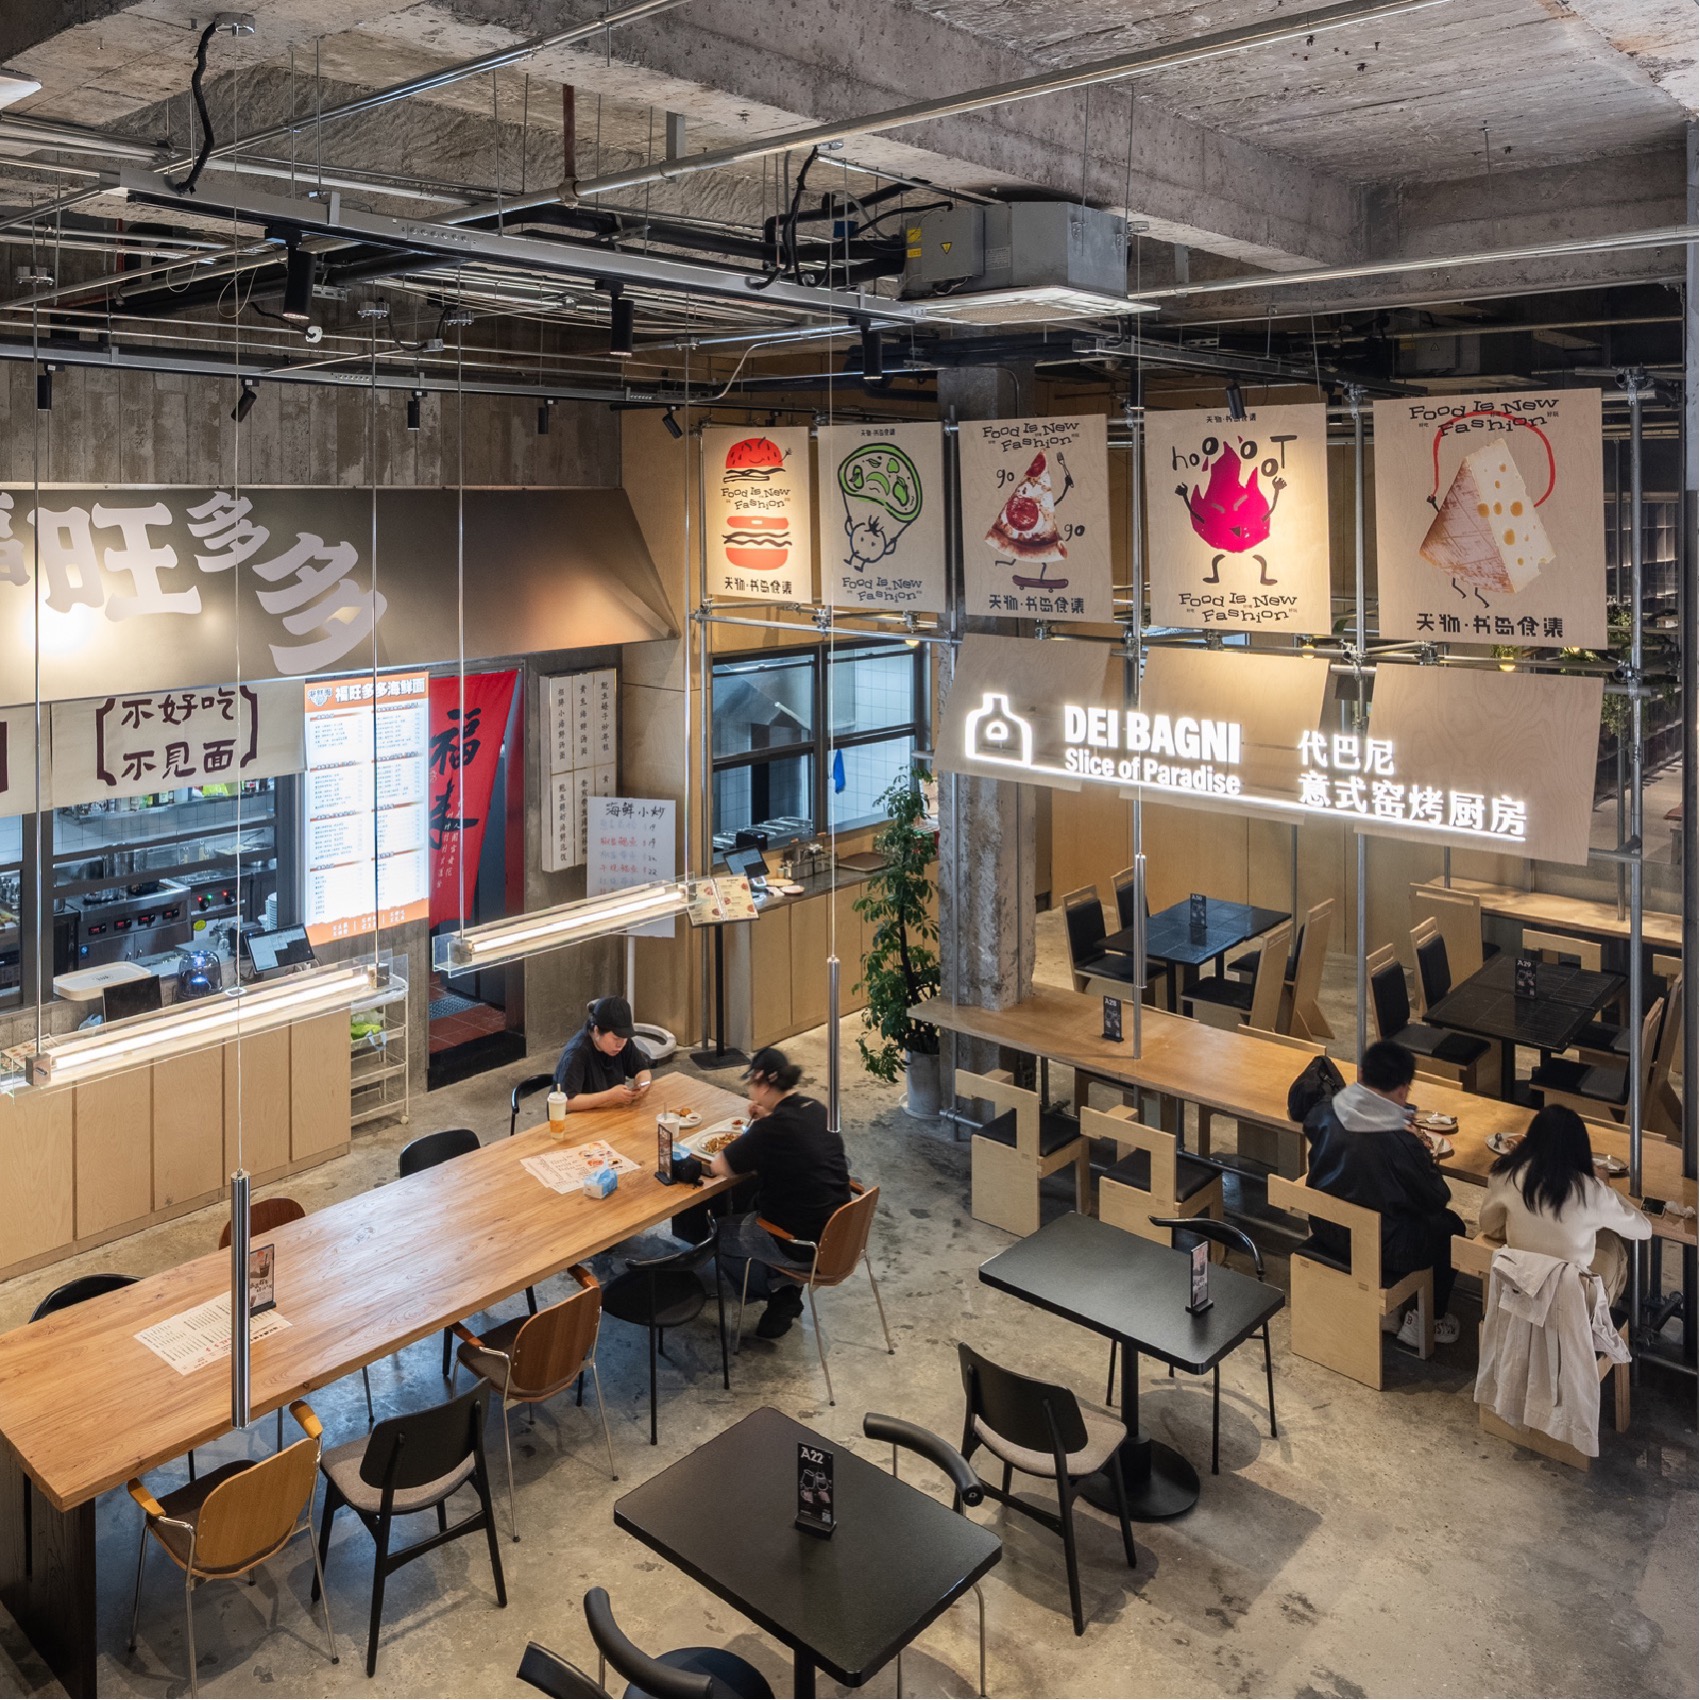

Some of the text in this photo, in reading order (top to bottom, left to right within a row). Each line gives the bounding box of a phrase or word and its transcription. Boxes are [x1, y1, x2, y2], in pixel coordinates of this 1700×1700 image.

[1409, 406, 1466, 420] Food
[1473, 400, 1494, 412] Is
[1501, 400, 1559, 414] New
[982, 422, 1080, 438] Food Is New
[1438, 416, 1547, 436] Fashion
[1001, 436, 1072, 452] Fashion
[996, 469, 1014, 488] go
[721, 486, 791, 498] Food Is New
[734, 498, 785, 510] Fashion
[1064, 523, 1085, 541] go
[0, 491, 388, 674] 旺多多
[842, 576, 922, 590] Food Is New
[857, 590, 917, 603] Fashion
[1178, 592, 1297, 608] Food Is New
[1202, 609, 1289, 623] Fashion
[336, 678, 425, 702] 福旺多多海鲜面
[121, 687, 236, 729] 不好吃
[1064, 705, 1241, 764] DEI BAGNI
[1297, 730, 1395, 776] 代巴尼
[1065, 748, 1240, 795] Slice of Paradise
[1297, 769, 1528, 835] 意式窑烤厨房
[801, 1446, 824, 1464] A22
